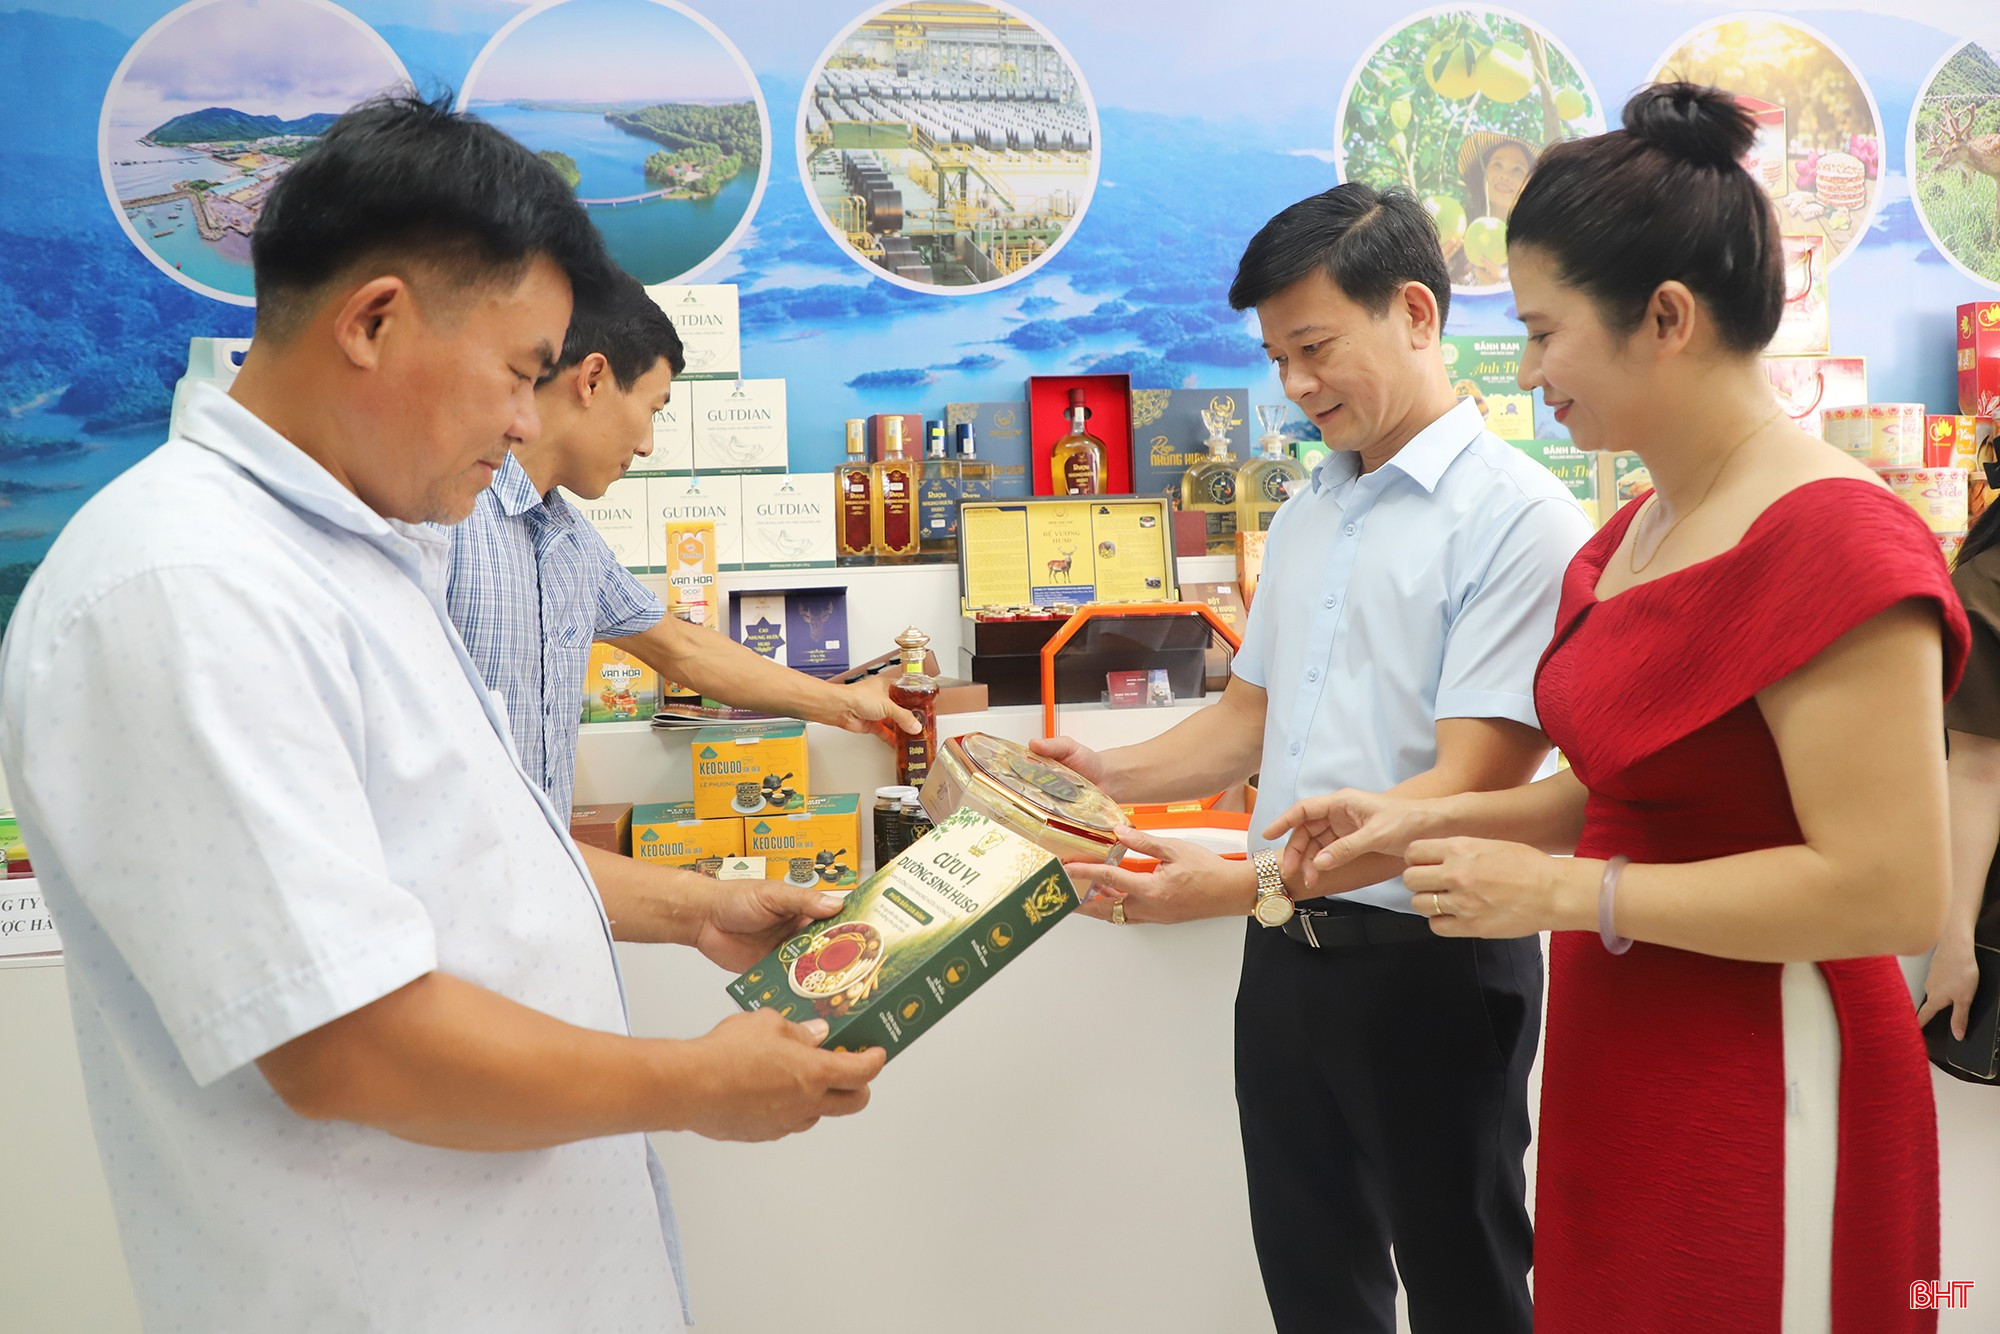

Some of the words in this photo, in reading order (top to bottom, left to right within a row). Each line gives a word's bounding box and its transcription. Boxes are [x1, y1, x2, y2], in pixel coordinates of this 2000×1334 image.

[670, 314, 723, 326] UTDIAN
[1474, 341, 1499, 350] BÁNH
[708, 409, 771, 422] GUTDIAN
[663, 506, 727, 519] GUTDIAN
[757, 503, 820, 515] GUTDIAN
[926, 875, 952, 896] SINH
[947, 889, 979, 914] HUSO
[18, 897, 41, 910] TY
